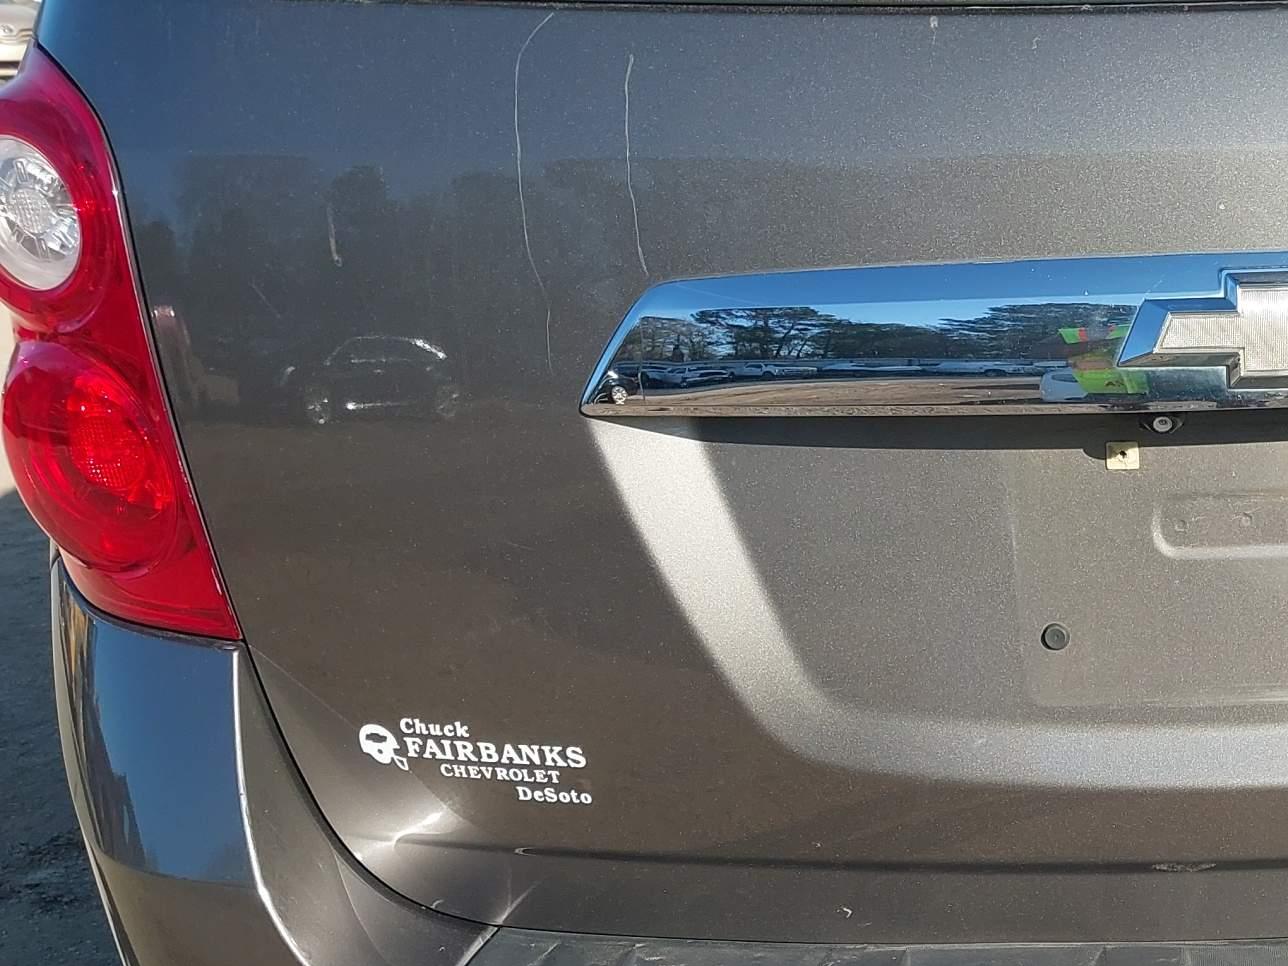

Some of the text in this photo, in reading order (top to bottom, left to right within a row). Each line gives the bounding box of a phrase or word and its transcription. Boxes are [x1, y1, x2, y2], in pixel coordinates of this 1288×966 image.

[400, 718, 470, 738] Chuck
[403, 736, 587, 768] FAIRBANKS
[440, 763, 560, 784] CHEVROLET
[516, 786, 593, 804] DeSoto
